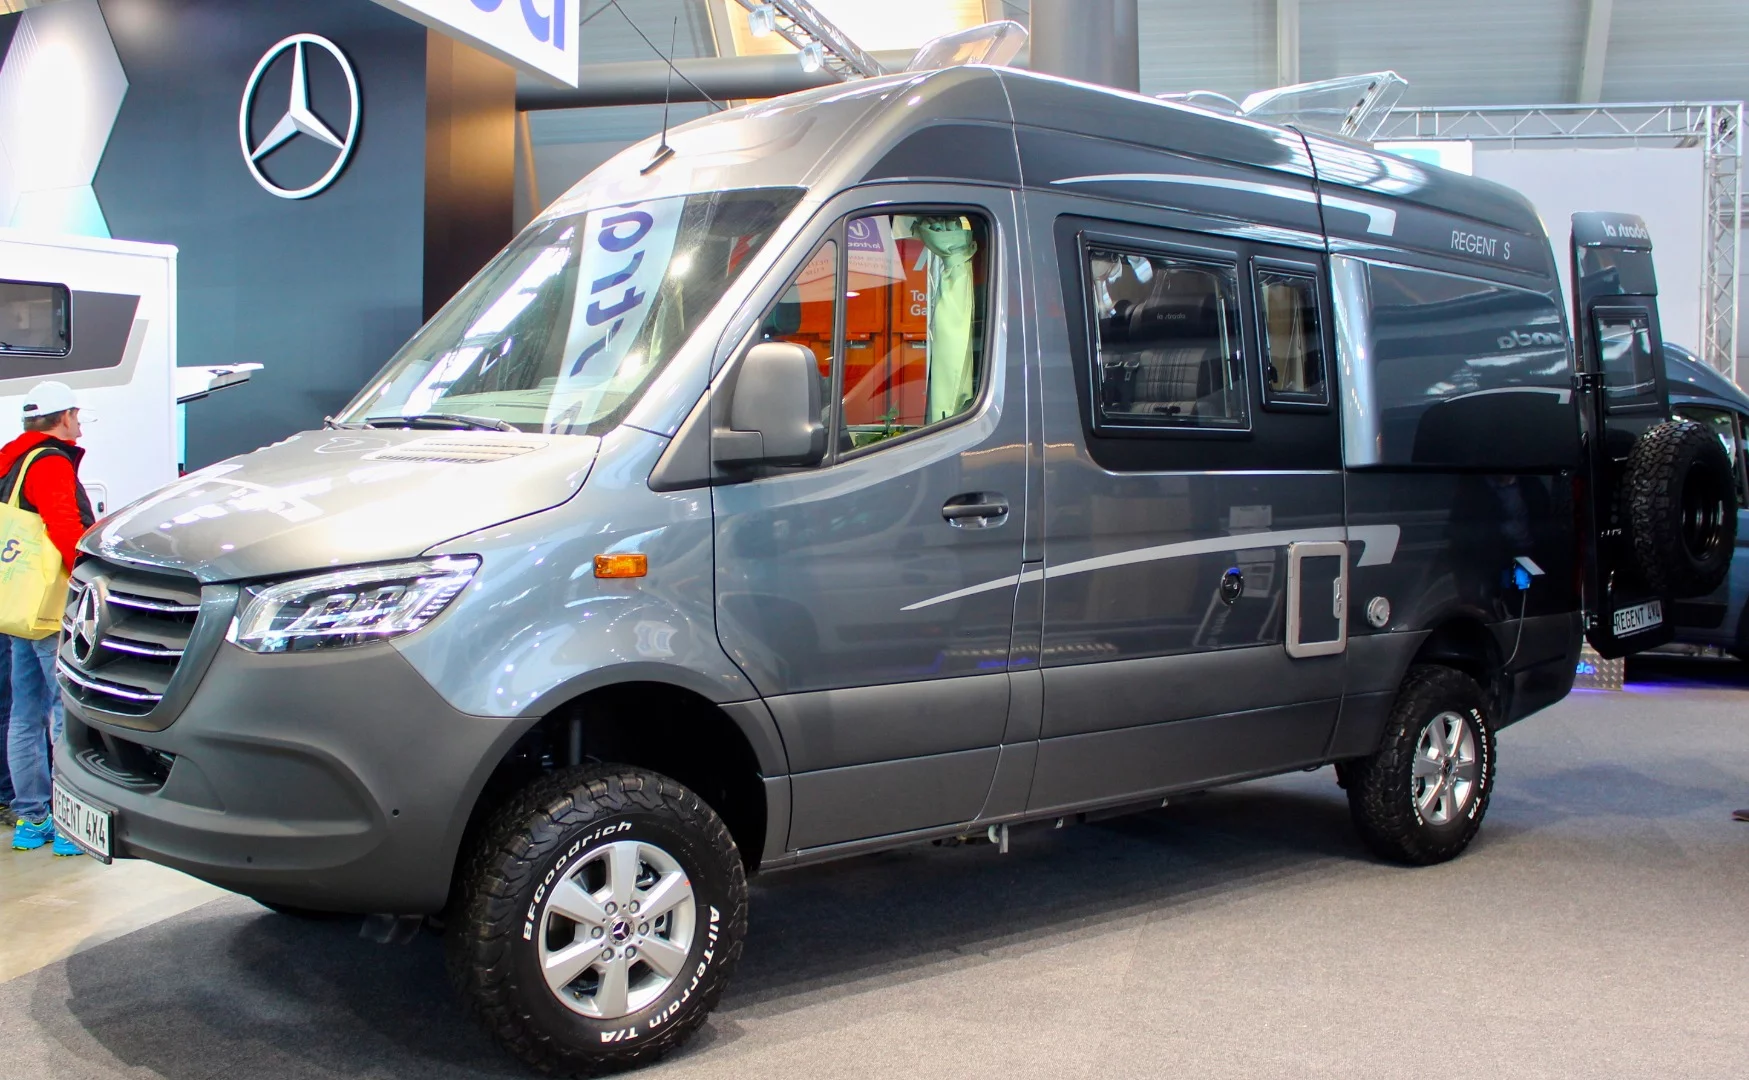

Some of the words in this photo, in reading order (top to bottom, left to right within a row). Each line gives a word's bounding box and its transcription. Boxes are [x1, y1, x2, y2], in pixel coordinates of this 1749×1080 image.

[1451, 230, 1497, 257] REGENT
[1503, 241, 1511, 260] S
[1601, 220, 1617, 237] la
[1619, 223, 1649, 240] strada
[1614, 608, 1645, 632] REGENT
[1470, 708, 1488, 789] All-Terrain
[54, 786, 82, 835] REGENT
[1467, 797, 1481, 820] T/A
[522, 821, 632, 941] BFGoodrich
[649, 905, 720, 1029] All-Terrain
[601, 1026, 639, 1043] T/A
